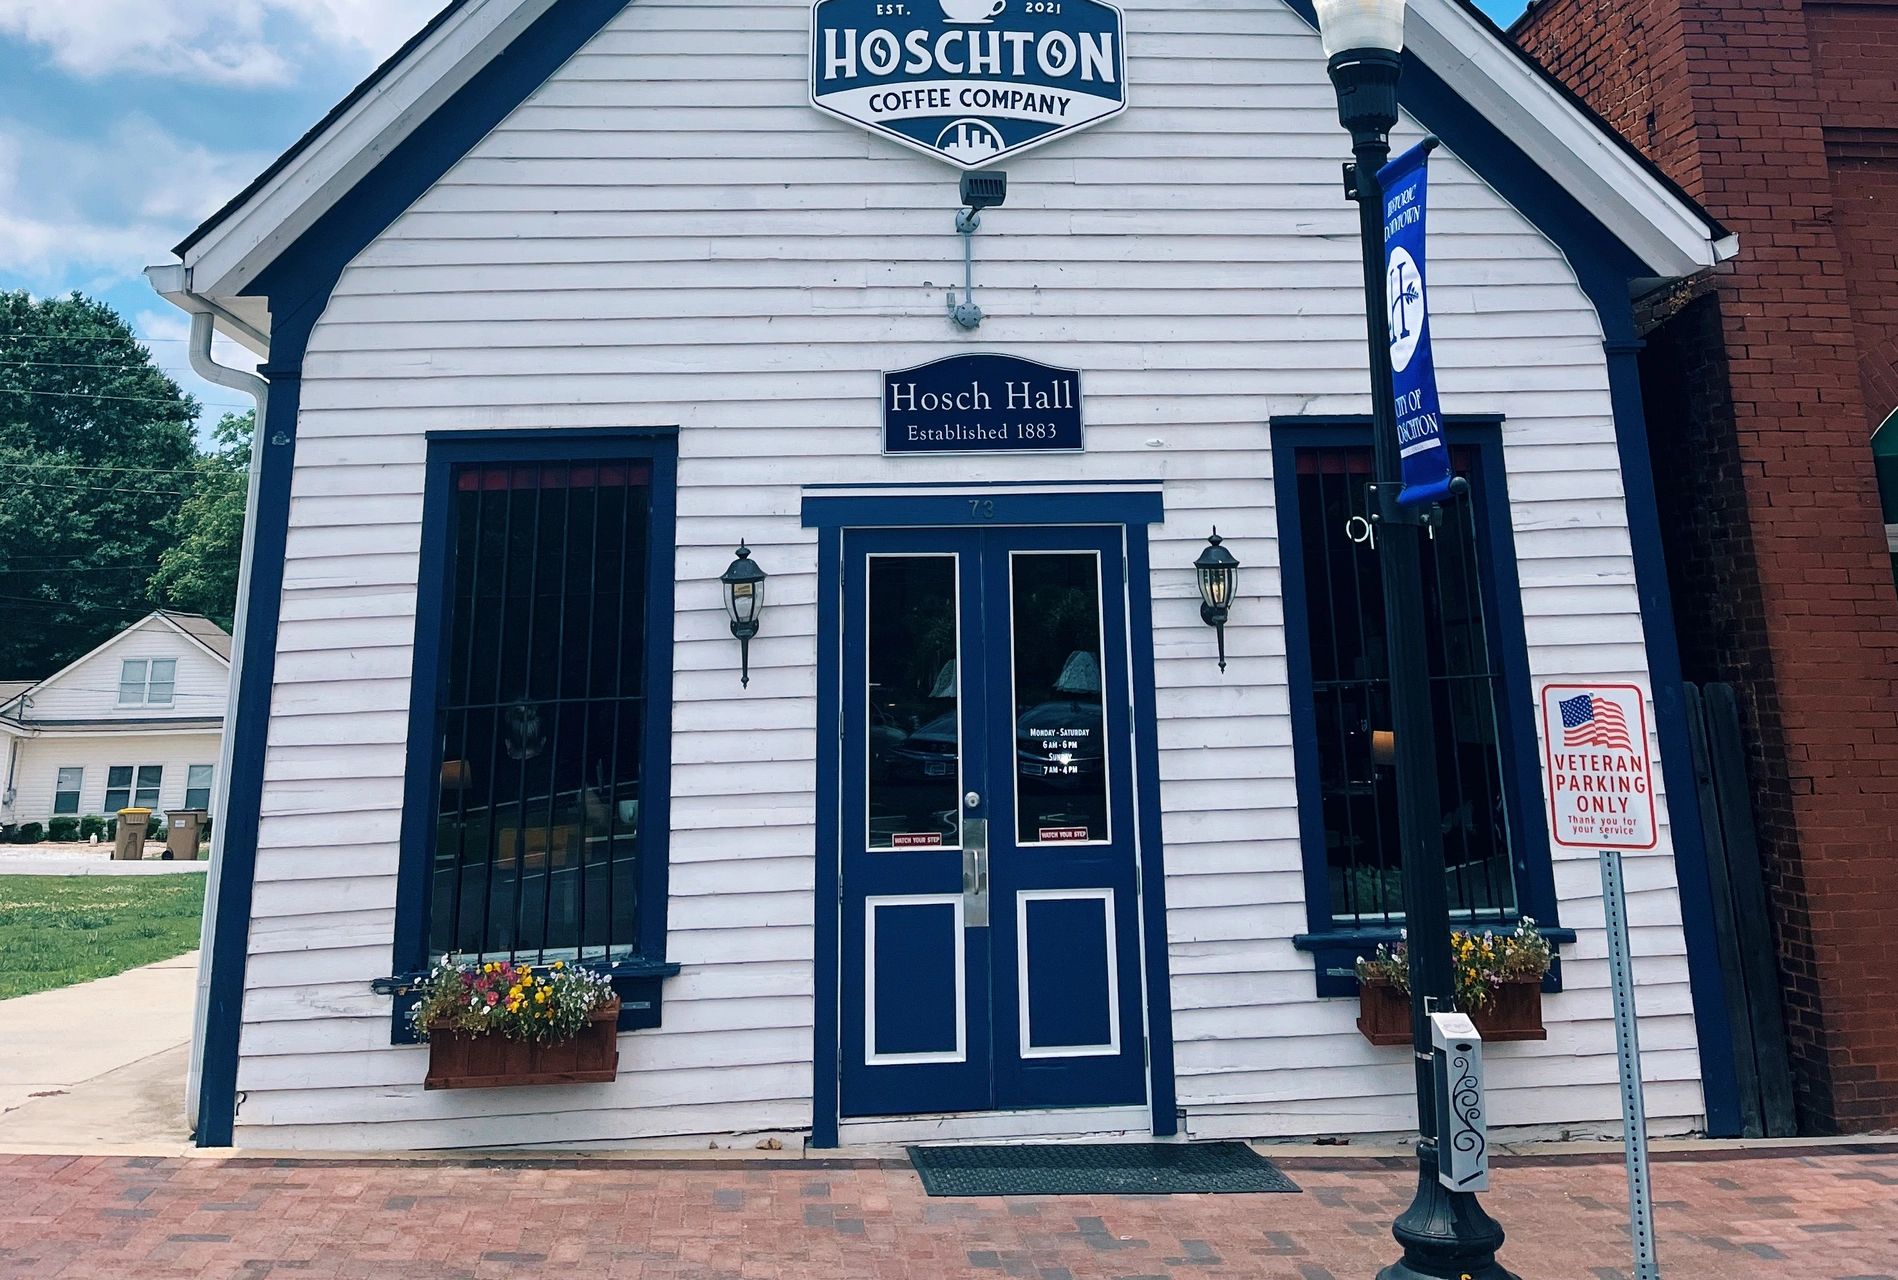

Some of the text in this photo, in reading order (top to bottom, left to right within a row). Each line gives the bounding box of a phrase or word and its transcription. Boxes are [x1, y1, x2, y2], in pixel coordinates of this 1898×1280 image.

[876, 1, 1061, 16] EST. 2021
[823, 28, 1115, 83] HOSCHTON
[869, 87, 1071, 116] COFFEE COMPANY
[890, 380, 1073, 411] Hosch Hall
[1408, 388, 1421, 411] OF
[908, 423, 1057, 441] Established 1883
[1396, 412, 1439, 444] OSCHTON
[968, 499, 994, 519] 73
[1048, 752, 1073, 762] SUNY
[1554, 754, 1643, 773] VETERAN
[1043, 766, 1048, 775] 7
[1062, 766, 1068, 775] 4
[1555, 774, 1646, 793] PARKING
[1576, 795, 1629, 813] ONLY
[1568, 815, 1637, 826] Thank you for
[1573, 825, 1634, 835] your service
